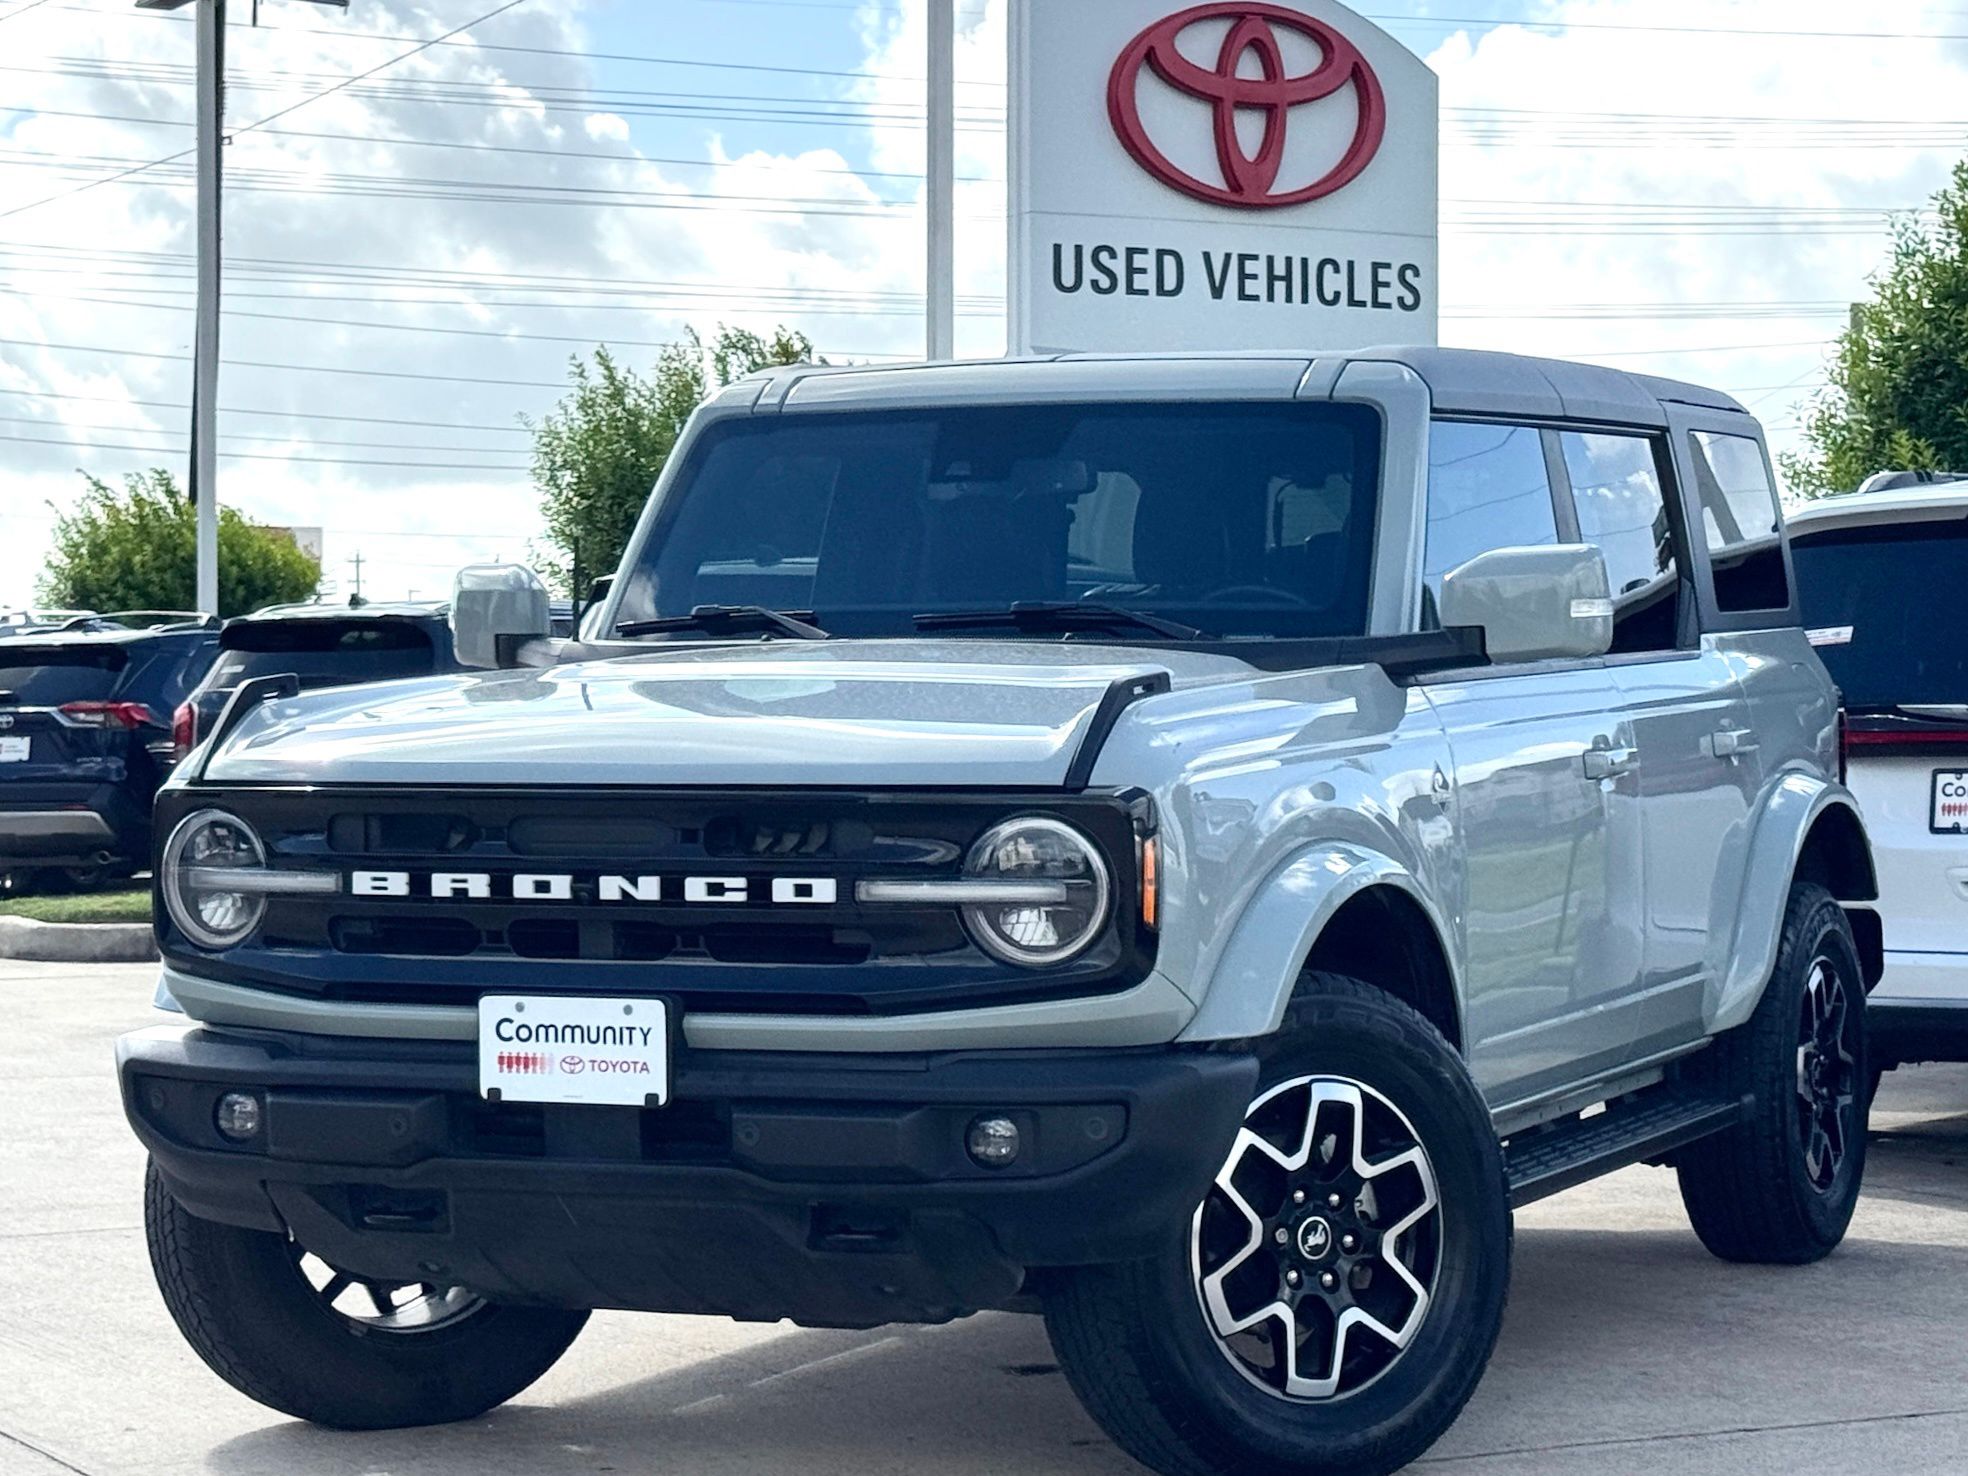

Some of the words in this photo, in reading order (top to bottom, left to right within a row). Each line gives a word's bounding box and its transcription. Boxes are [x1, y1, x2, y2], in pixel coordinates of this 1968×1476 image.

[1052, 243, 1185, 298] USED
[1202, 251, 1421, 312] VEHICLES
[351, 870, 838, 904] BRONCO
[588, 1058, 651, 1075] TOYOTA
